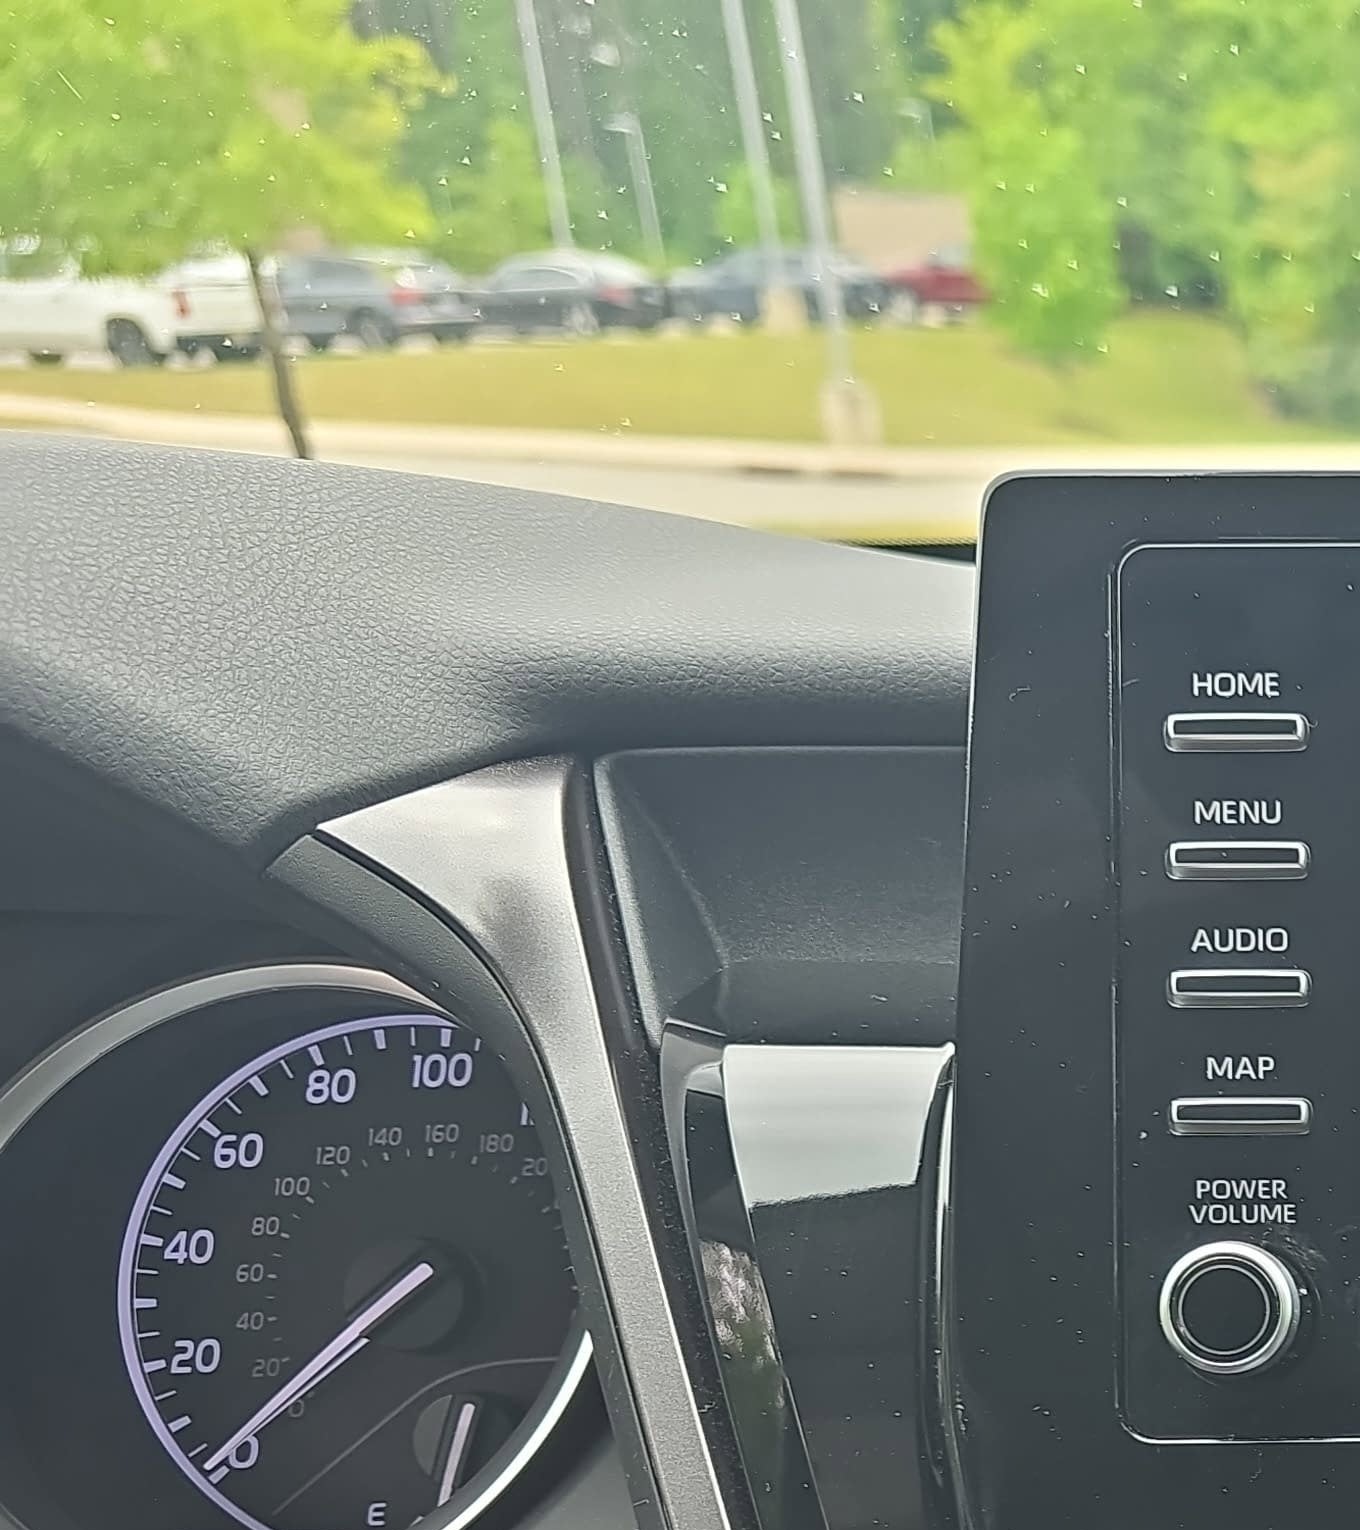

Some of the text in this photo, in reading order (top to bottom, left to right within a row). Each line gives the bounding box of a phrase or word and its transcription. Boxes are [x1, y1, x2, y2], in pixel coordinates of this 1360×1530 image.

[1192, 672, 1280, 698] HOME
[1194, 800, 1282, 825] MENU
[1190, 927, 1288, 953] AUDIO
[412, 1052, 473, 1088] 100
[1206, 1056, 1275, 1080] MAP
[305, 1068, 356, 1104] 80
[368, 1126, 402, 1146] 140
[425, 1123, 460, 1143] 160
[480, 1133, 514, 1153] 180
[213, 1133, 264, 1168] 60
[316, 1145, 351, 1165] 120
[274, 1176, 311, 1196] 100
[1196, 1179, 1288, 1200] POWER
[1188, 1204, 1297, 1225] VOLUME
[251, 1216, 281, 1236] 80
[163, 1229, 215, 1266] 40
[235, 1263, 264, 1284] 60
[235, 1311, 265, 1331] 40
[170, 1338, 221, 1374] 20
[251, 1358, 280, 1378] 20
[228, 1434, 259, 1469] 0
[367, 1502, 387, 1526] E
